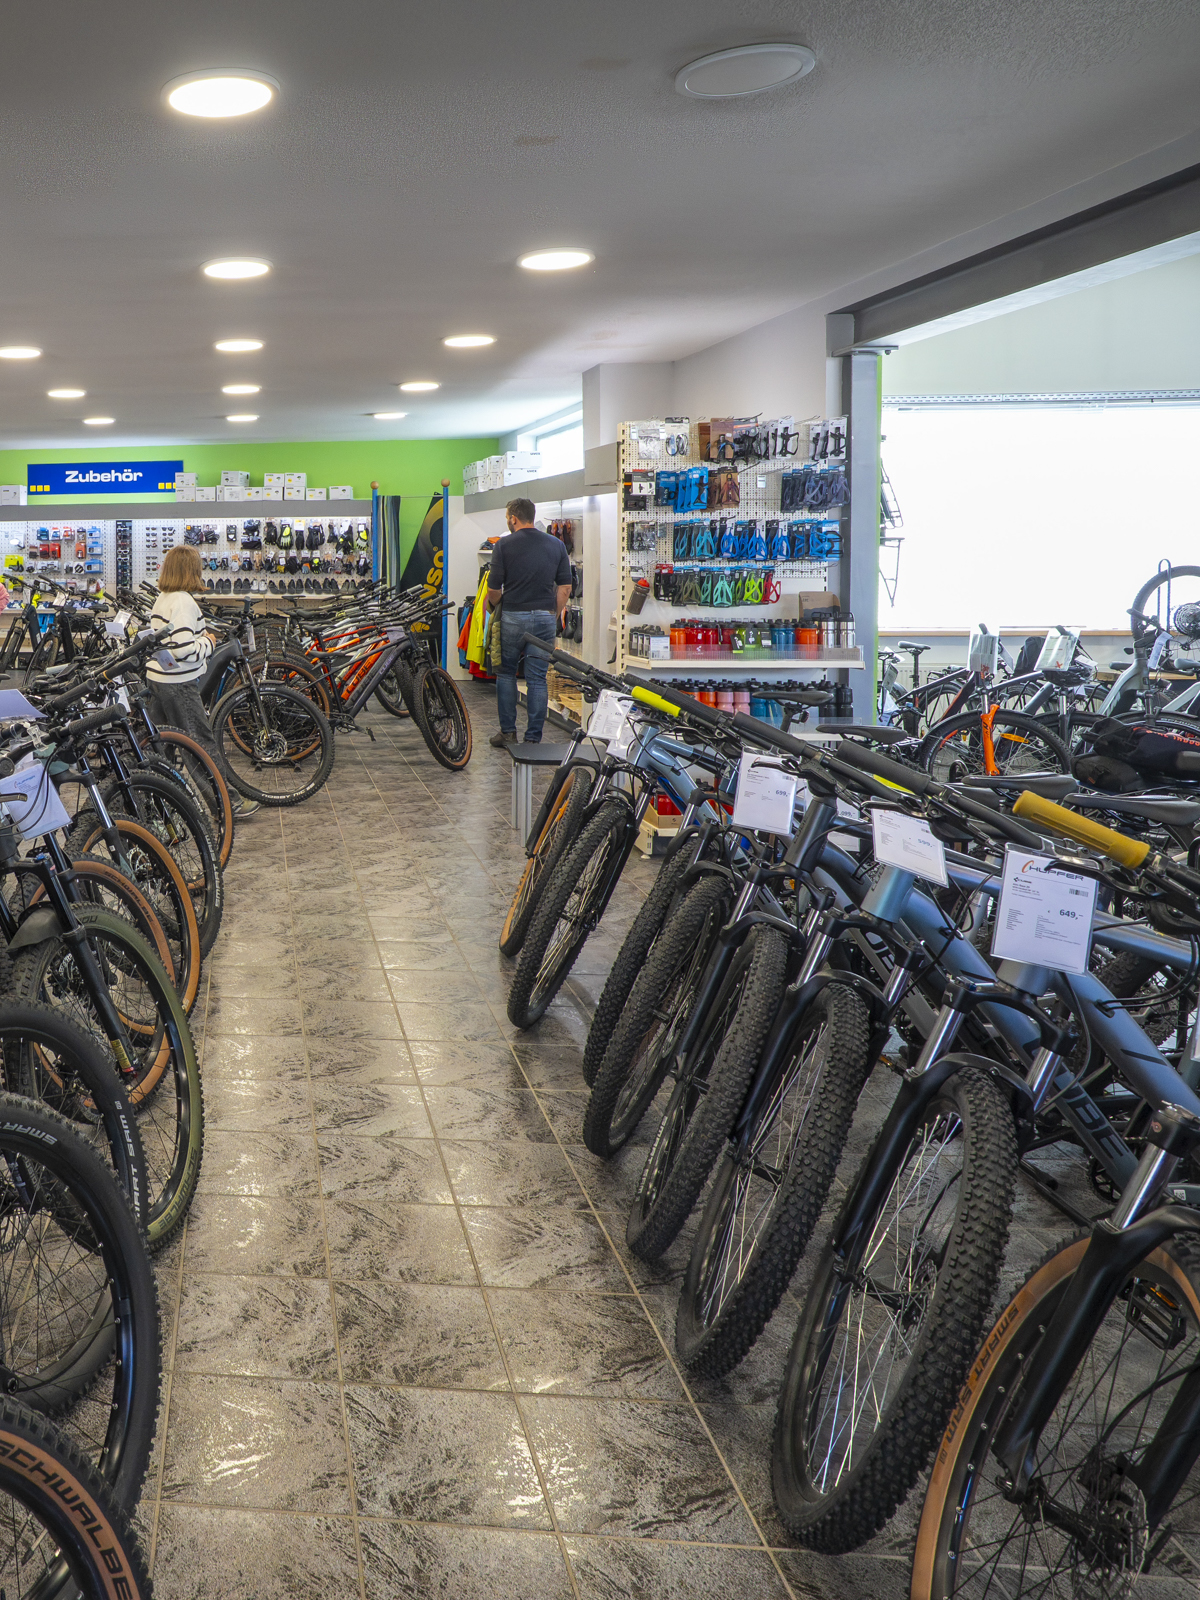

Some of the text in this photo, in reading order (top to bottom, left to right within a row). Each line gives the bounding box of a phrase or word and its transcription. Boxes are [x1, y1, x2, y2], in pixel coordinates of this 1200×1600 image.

[65, 469, 143, 483] Zubehör
[104, 871, 154, 922] SCHWALBE
[1029, 866, 1084, 881] HUPFER
[120, 1114, 135, 1157] SAM
[158, 1147, 198, 1230] SCHWALBE
[946, 1303, 1020, 1444] SMART SAM
